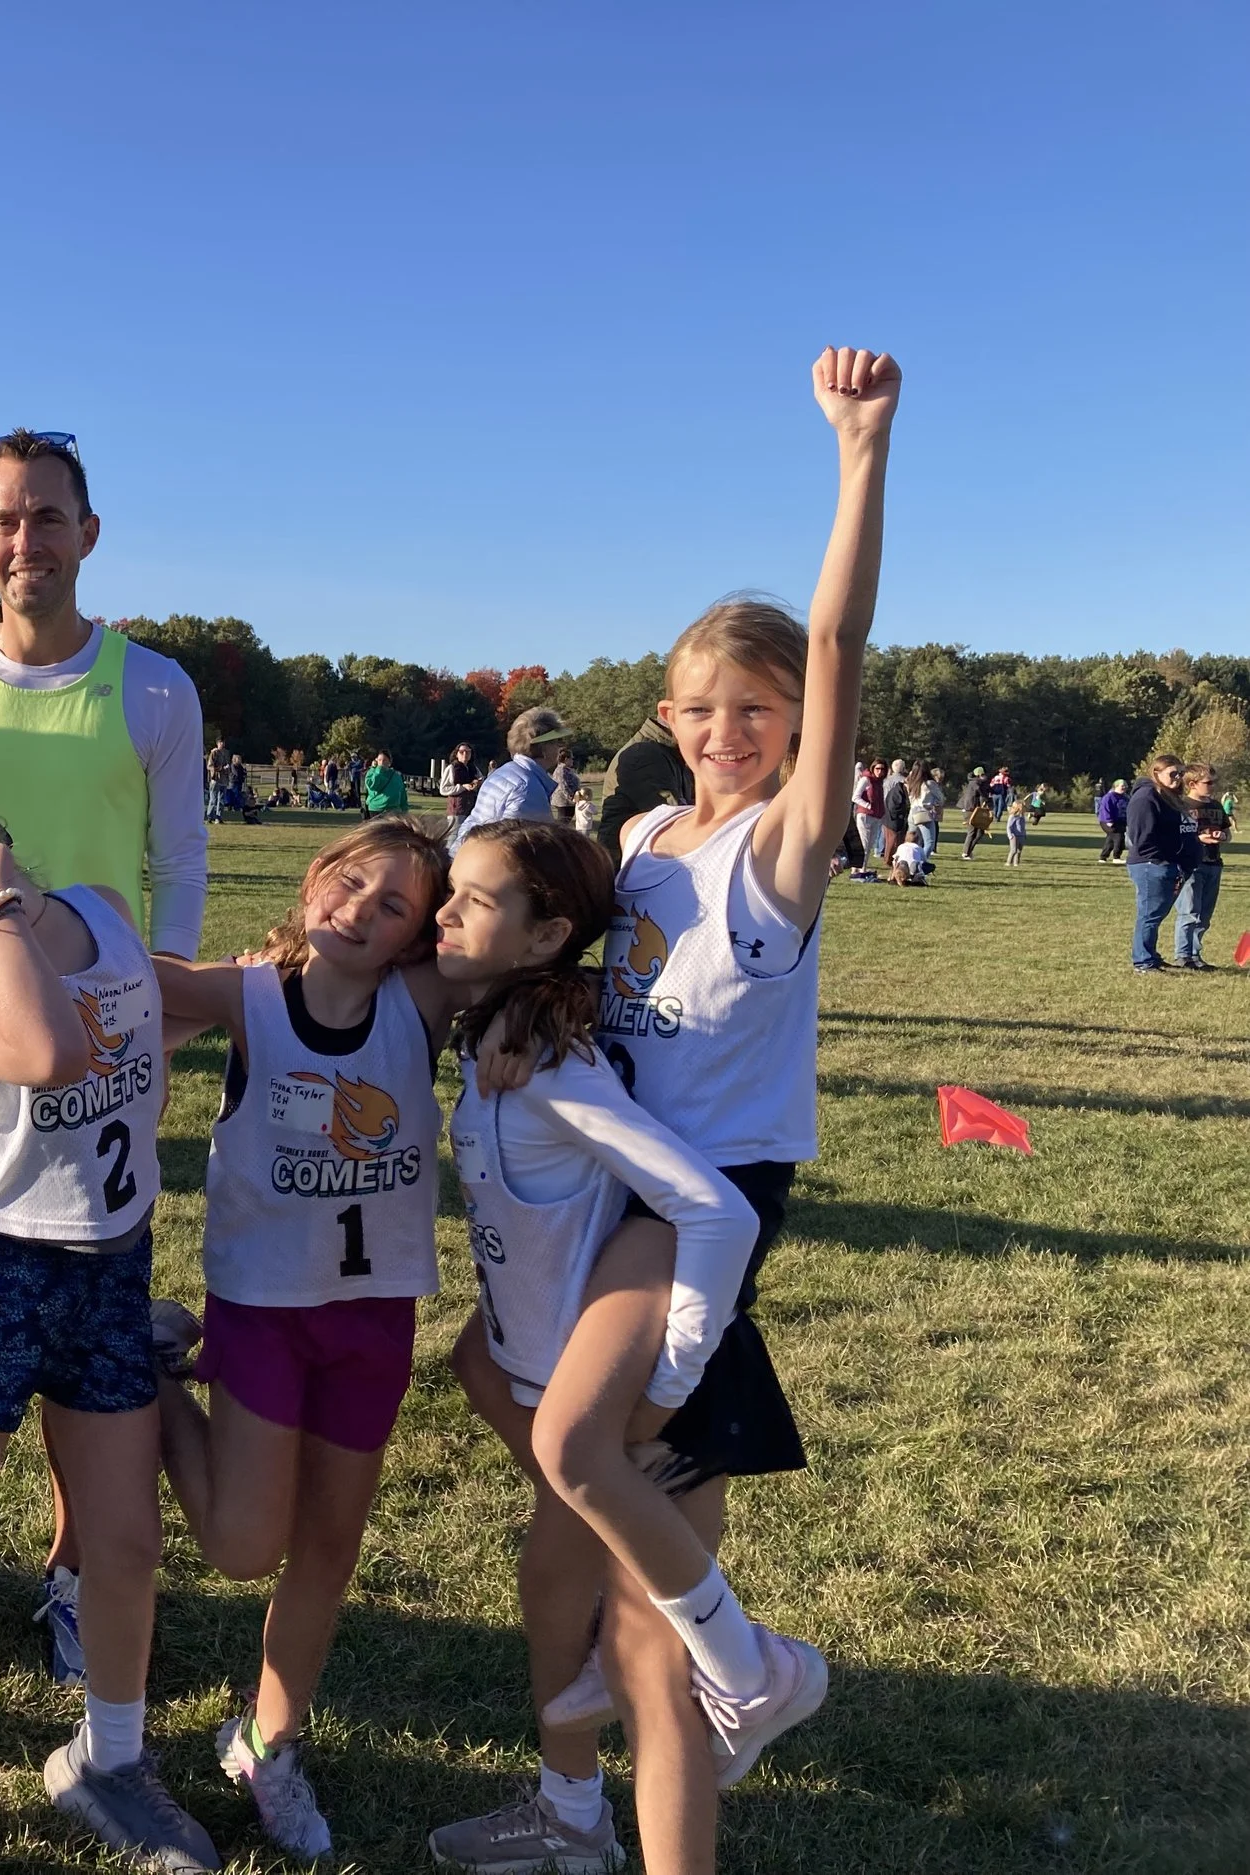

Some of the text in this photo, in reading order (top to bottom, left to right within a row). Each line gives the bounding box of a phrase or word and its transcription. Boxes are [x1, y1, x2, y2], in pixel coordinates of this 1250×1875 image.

[100, 1001, 117, 1014] TCH
[31, 1053, 152, 1133] COMETS
[271, 1091, 289, 1105] TCH
[293, 1085, 325, 1100] Taylor
[95, 1118, 138, 1215] 2
[271, 1145, 421, 1198] COMETS
[336, 1203, 372, 1277] 1
